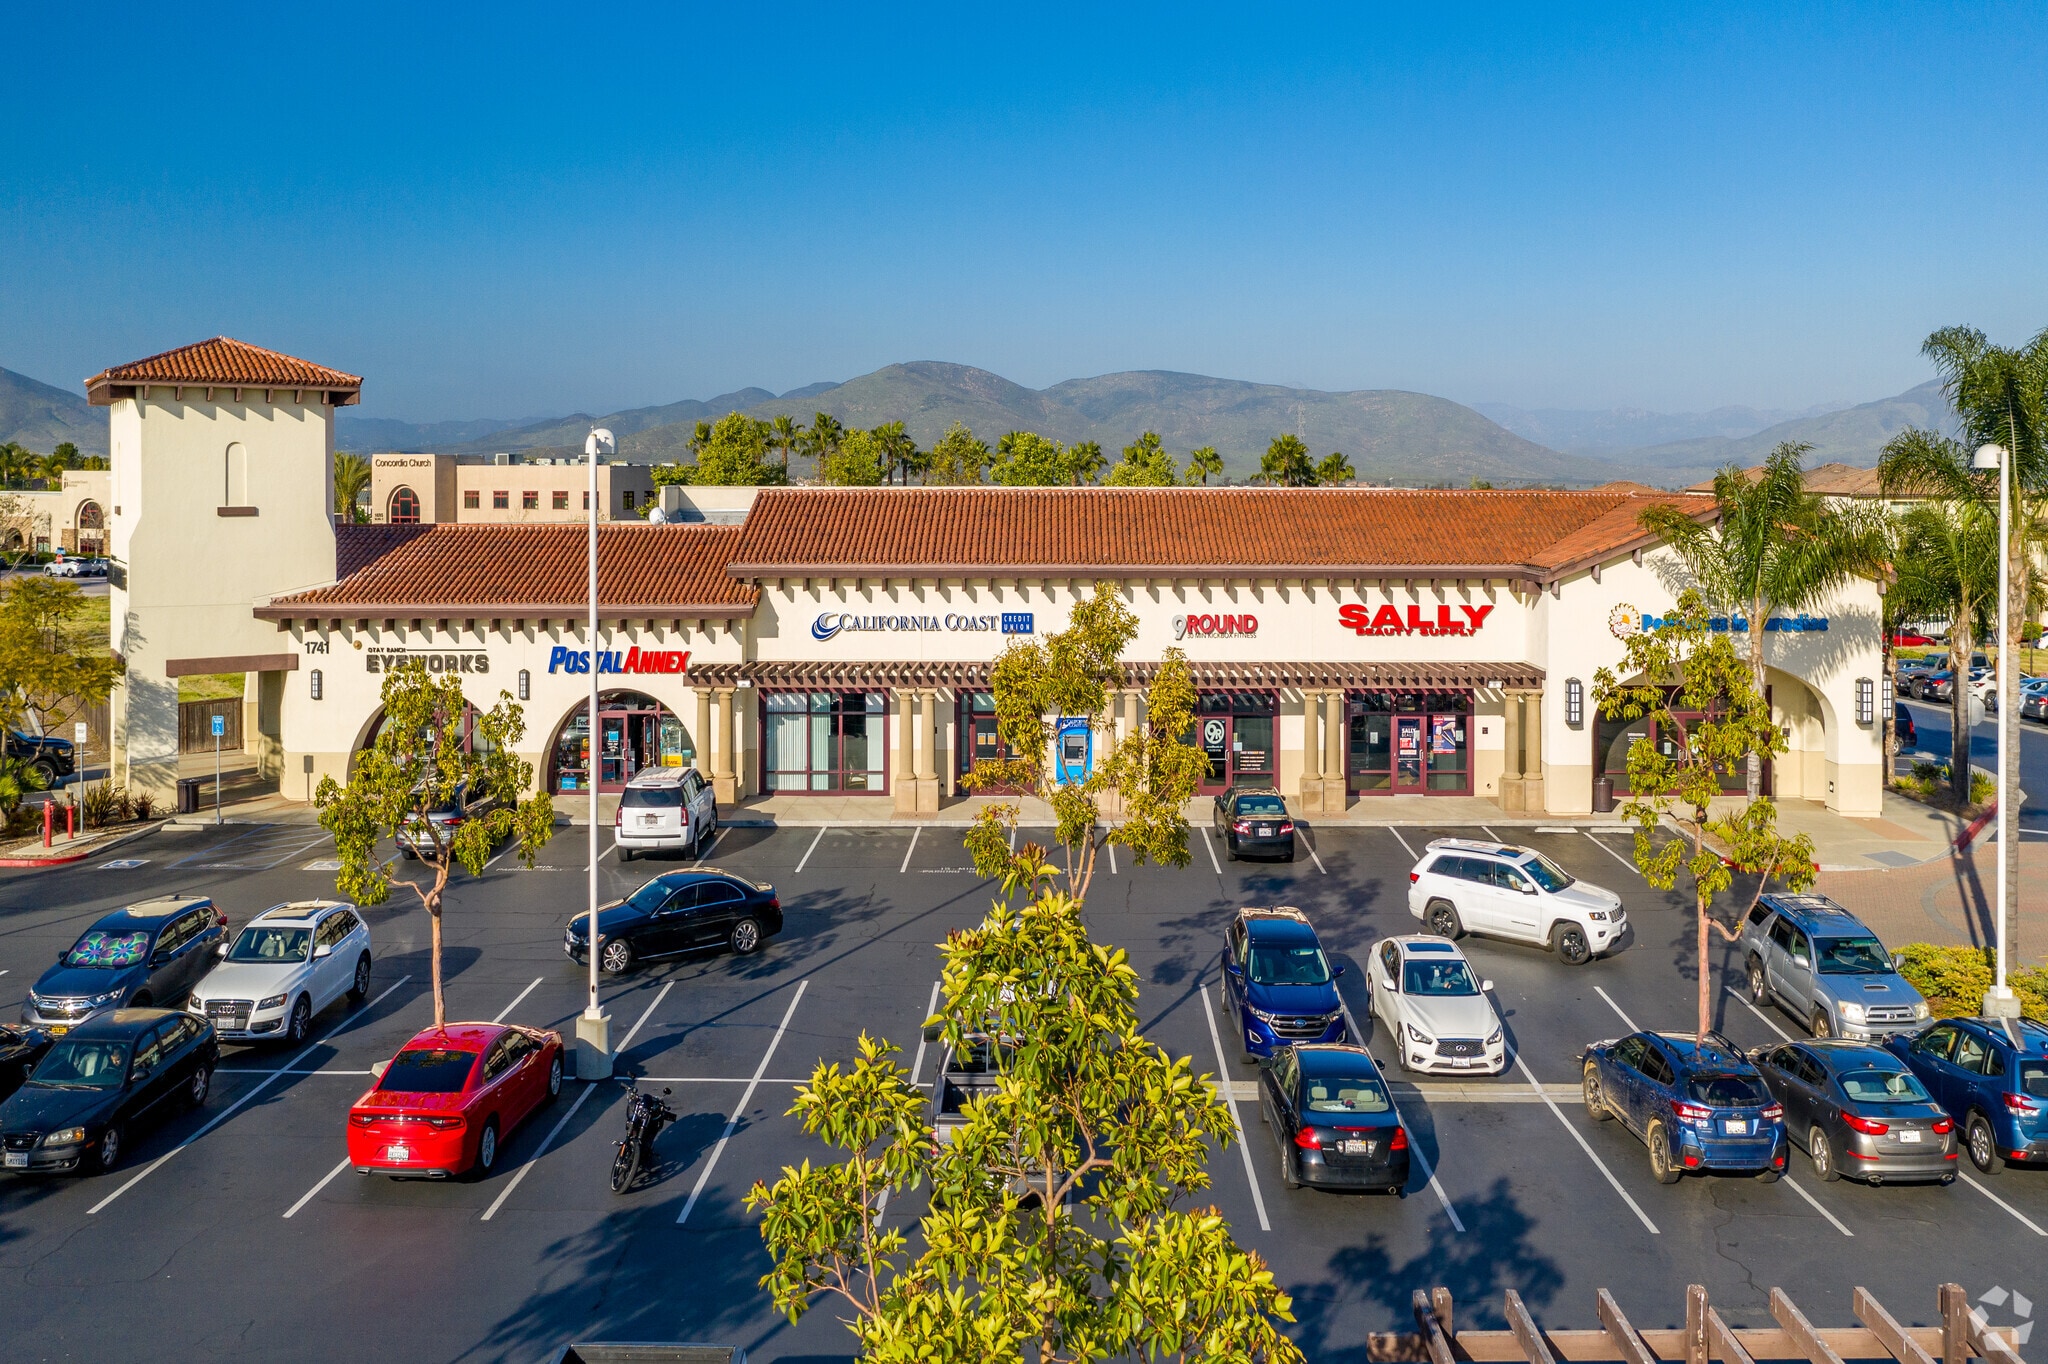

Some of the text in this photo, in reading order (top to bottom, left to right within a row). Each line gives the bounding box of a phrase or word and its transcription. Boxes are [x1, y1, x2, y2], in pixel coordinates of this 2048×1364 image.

[375, 458, 432, 468] Concordia Church
[1003, 615, 1031, 623] CREDIT
[1338, 603, 1495, 629] SALLY
[838, 612, 1000, 631] CALIFORNIA COAST
[1003, 623, 1031, 631] UNION
[1355, 627, 1477, 637] BEAUTY SUPPLY
[305, 641, 330, 655] 1741
